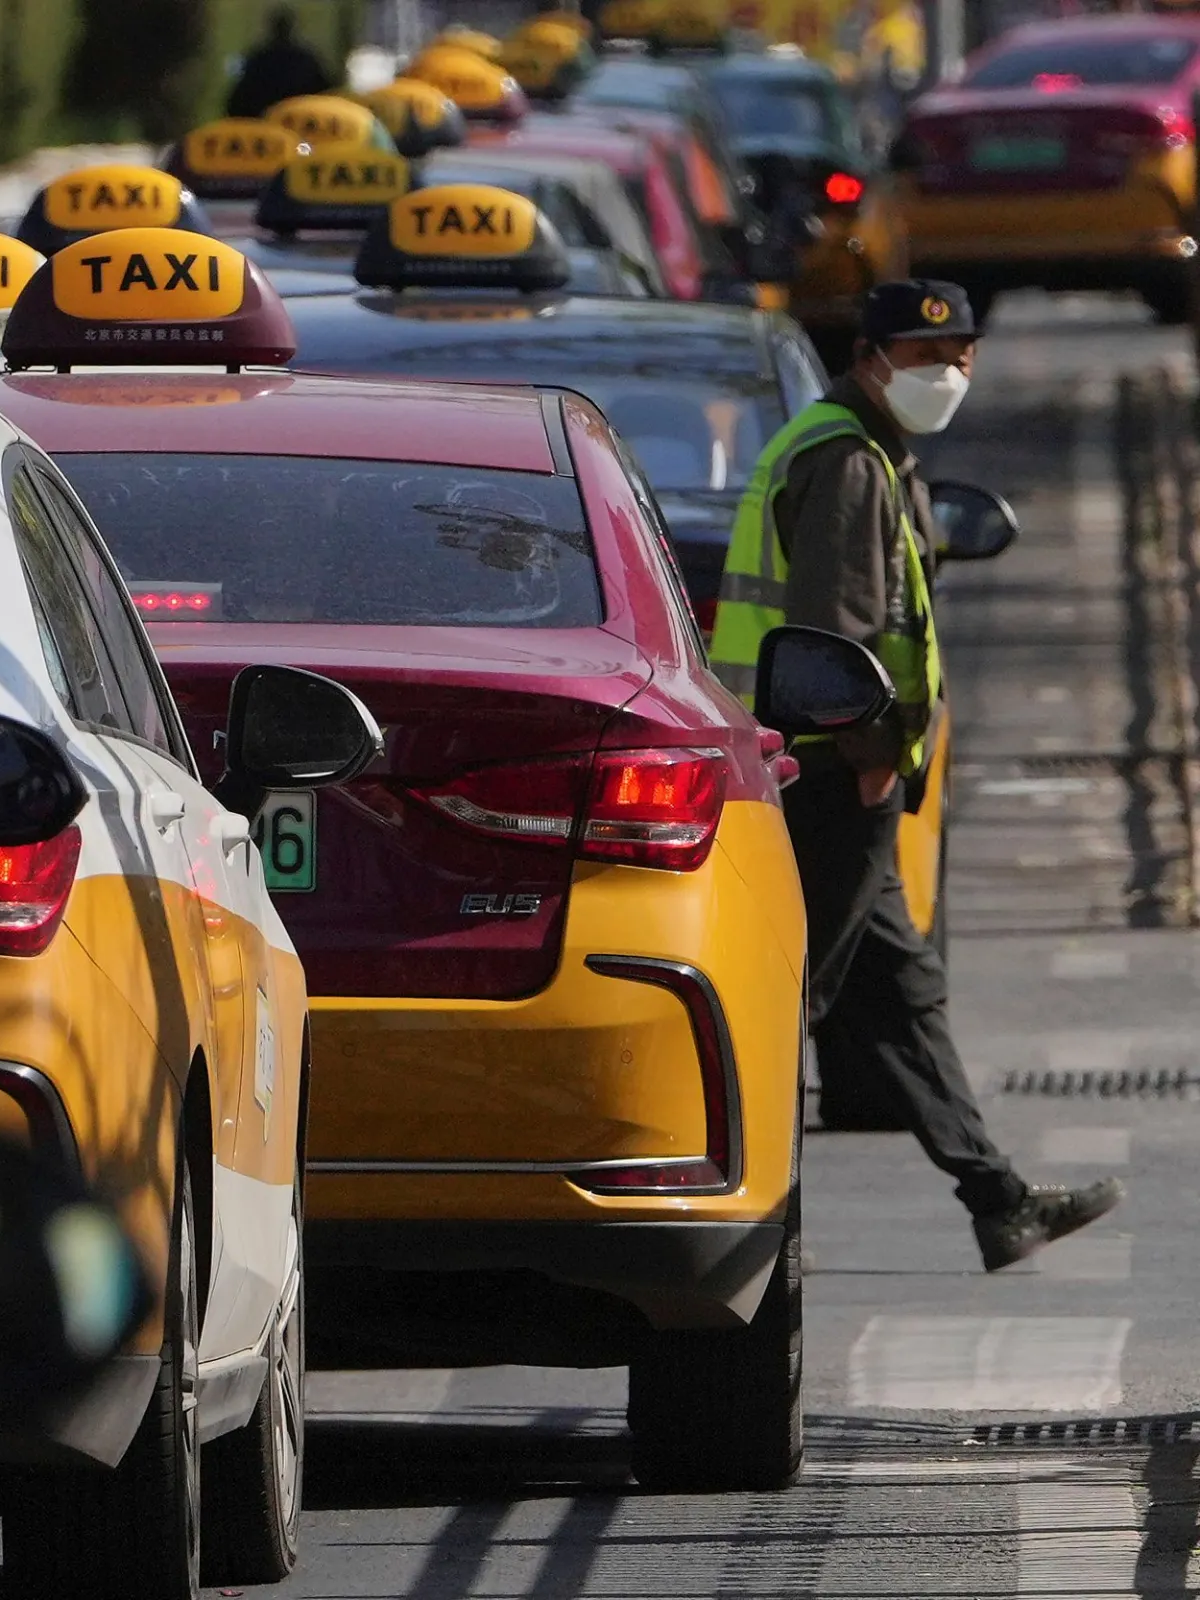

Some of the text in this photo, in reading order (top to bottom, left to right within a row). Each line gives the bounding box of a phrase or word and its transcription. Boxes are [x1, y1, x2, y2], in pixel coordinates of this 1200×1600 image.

[308, 163, 397, 188] TAXI
[66, 181, 162, 212] TAXI
[412, 205, 513, 236] TAXI
[81, 253, 219, 294] TAXI
[84, 329, 224, 341] 北京市交通委员会监制
[257, 807, 304, 874] 6
